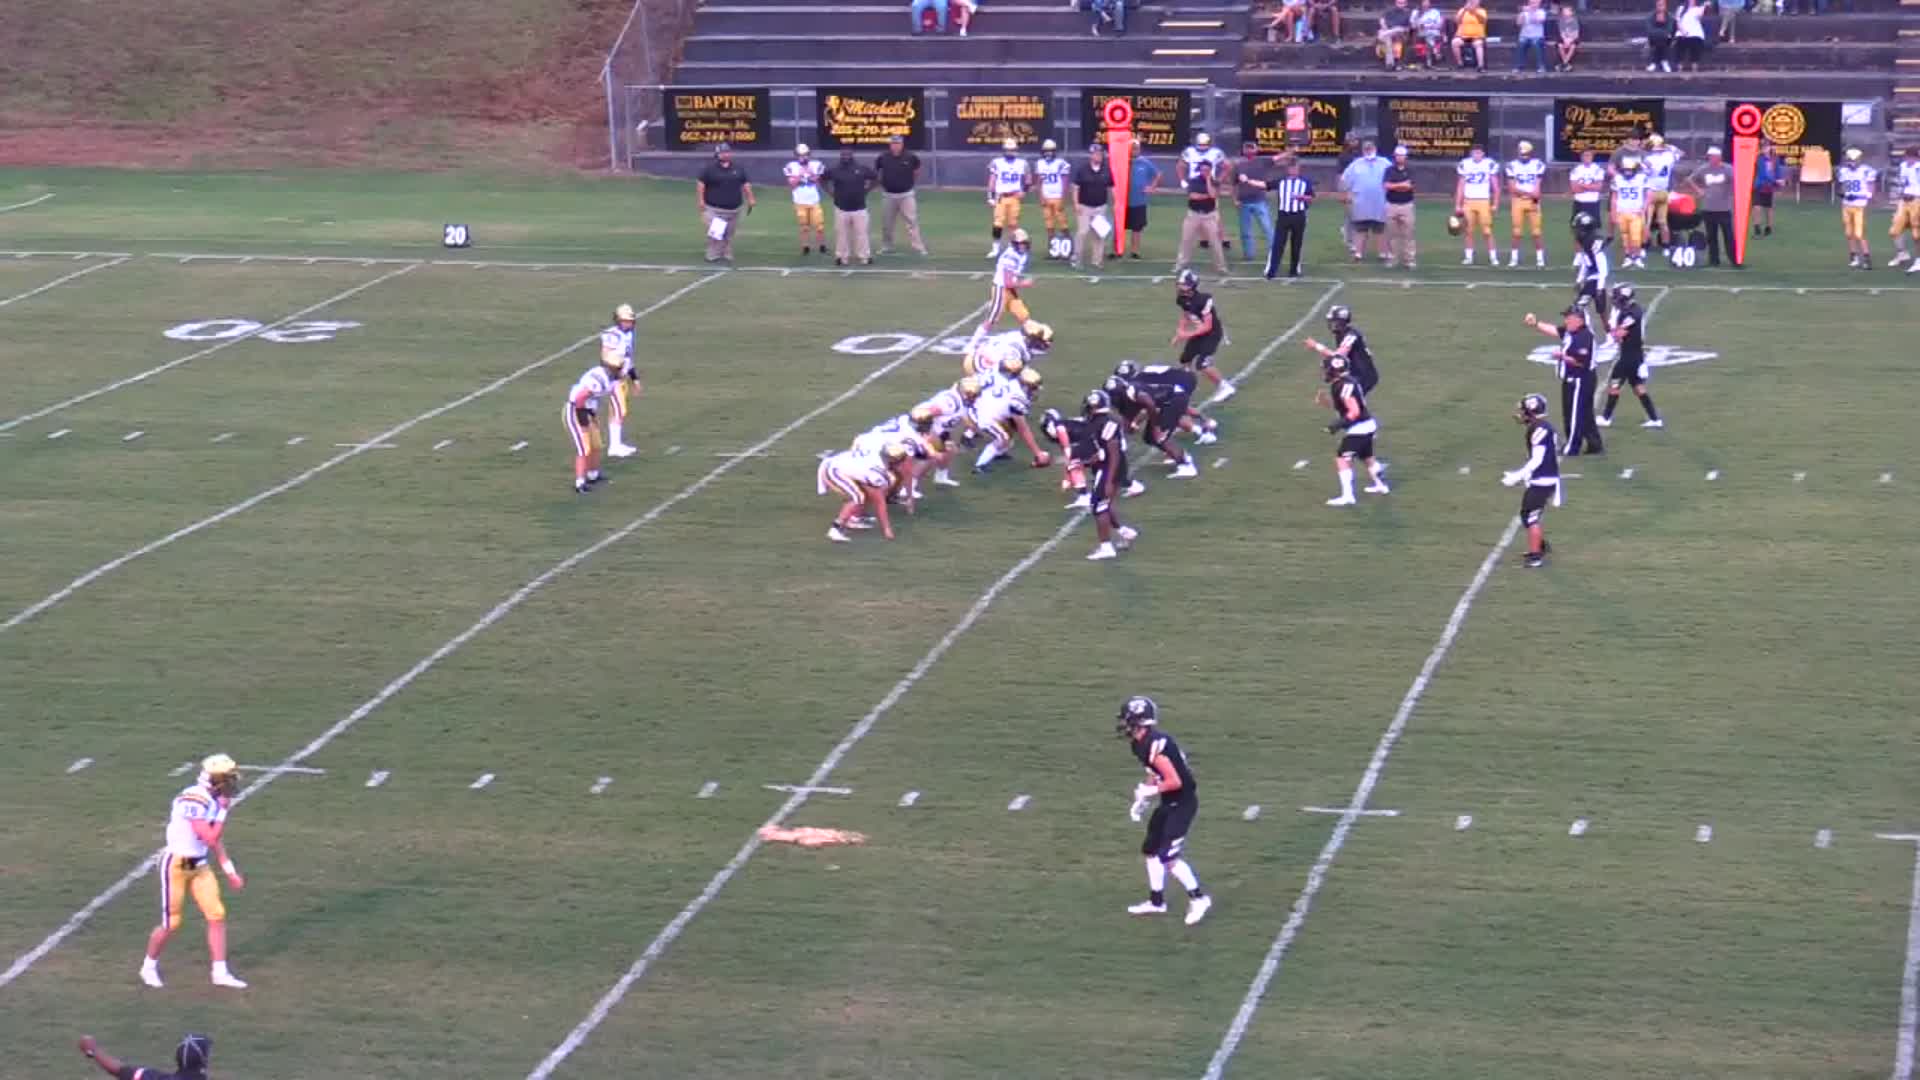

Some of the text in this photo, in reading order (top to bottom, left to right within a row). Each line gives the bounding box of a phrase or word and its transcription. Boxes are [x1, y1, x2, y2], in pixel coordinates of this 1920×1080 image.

[693, 95, 756, 109] BAPTIST
[1136, 96, 1178, 109] PORCH
[1286, 106, 1306, 130] 2
[1256, 128, 1337, 139] KITEN
[1465, 171, 1486, 184] 27
[1619, 187, 1639, 200] 55
[444, 225, 468, 246] 20
[1048, 237, 1073, 257] 30
[1671, 247, 1696, 267] 40
